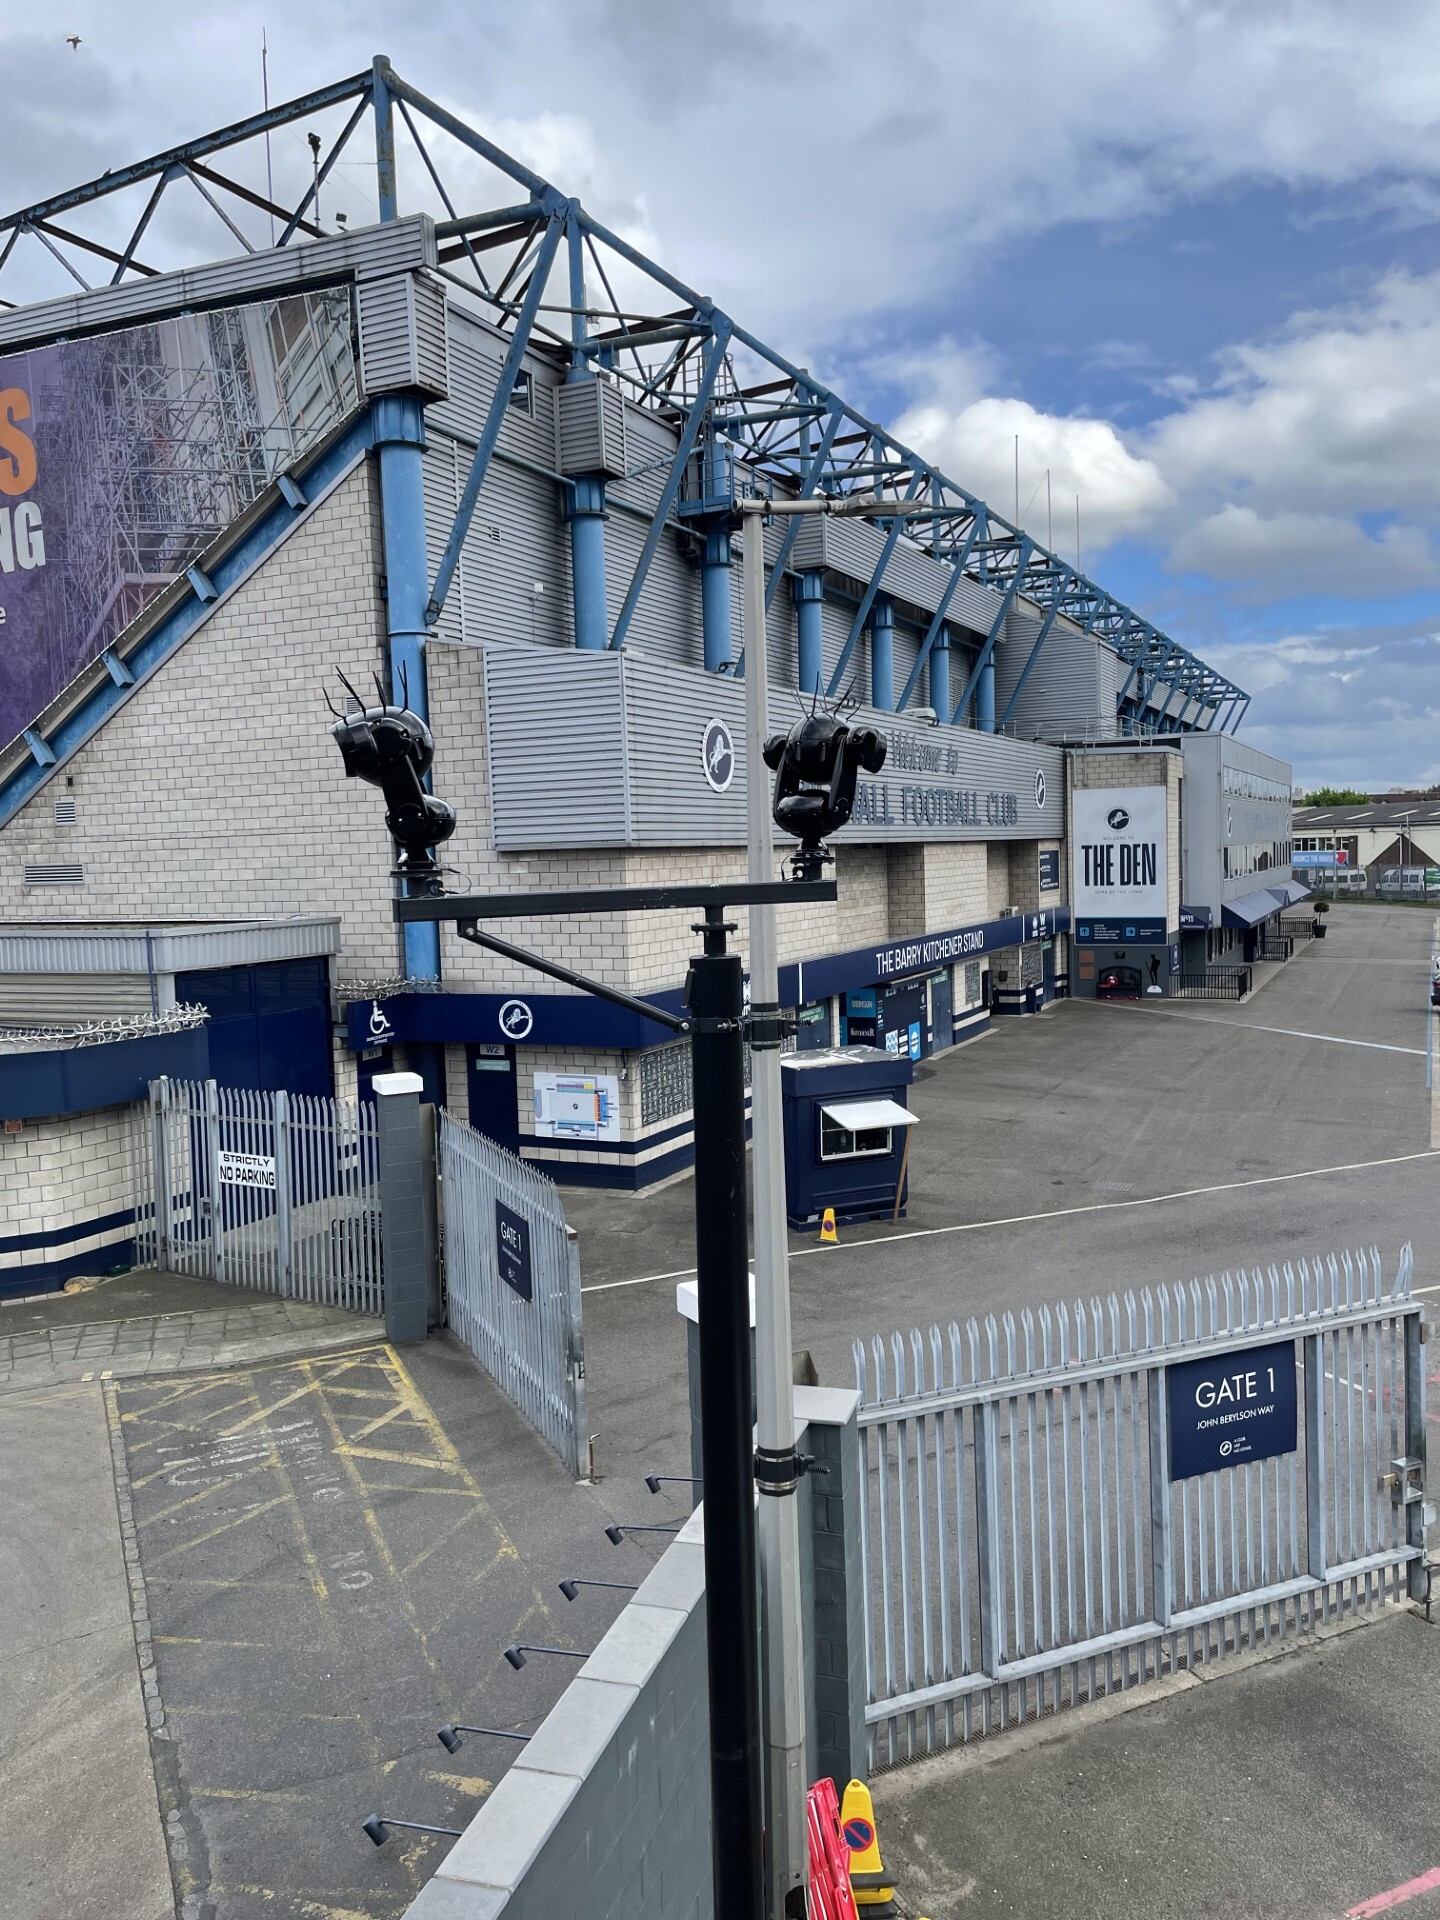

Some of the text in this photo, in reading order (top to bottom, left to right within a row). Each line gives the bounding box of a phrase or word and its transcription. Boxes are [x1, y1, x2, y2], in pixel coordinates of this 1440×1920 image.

[902, 787, 982, 826] FOOTBALL
[987, 791, 1018, 826] CLUB
[1081, 843, 1156, 887] THE DEN
[876, 930, 984, 975] THE BARRY KITCHENER STAND
[485, 1045, 499, 1054] W2
[223, 1153, 270, 1167] STRICTLY
[219, 1165, 275, 1187] NO PARKING
[500, 1221, 522, 1252] GATE 1
[1195, 1367, 1275, 1408] GATE 1
[1196, 1404, 1275, 1430] JOHN BERYLSON WAY
